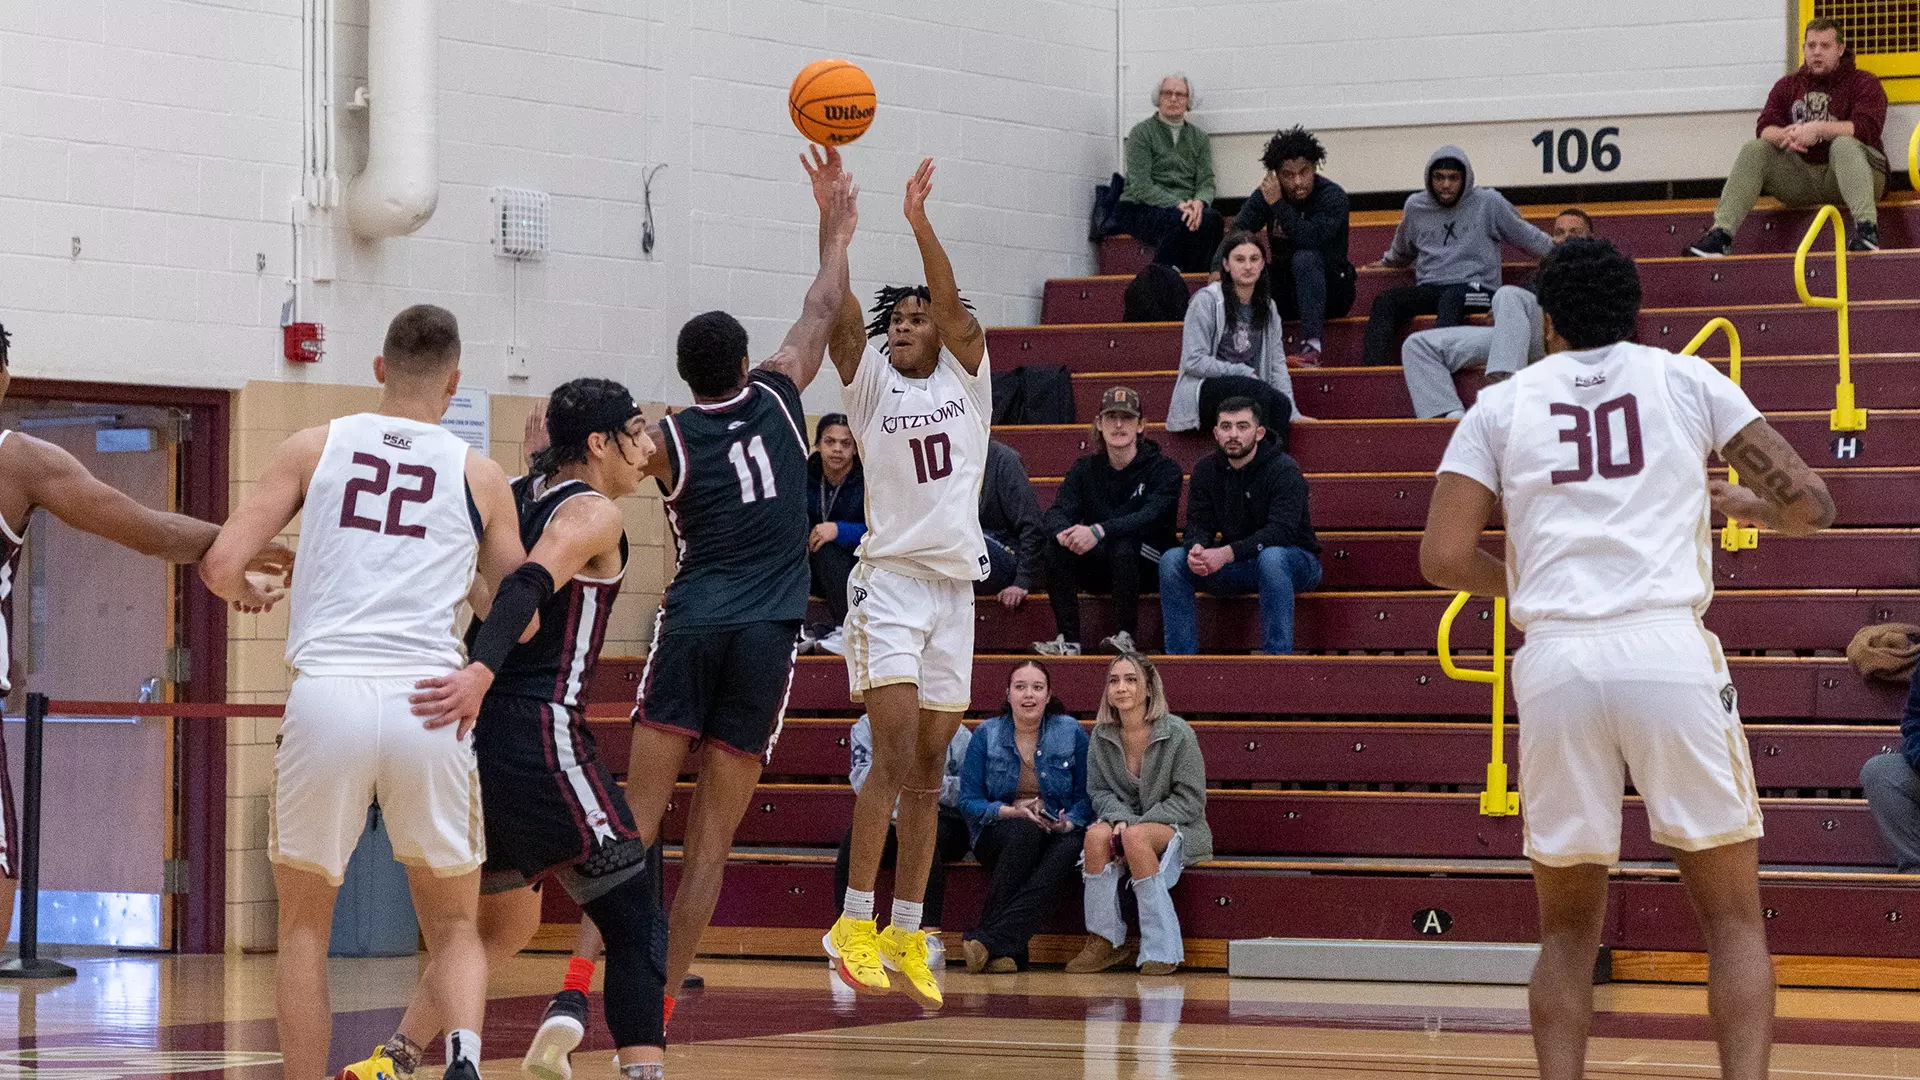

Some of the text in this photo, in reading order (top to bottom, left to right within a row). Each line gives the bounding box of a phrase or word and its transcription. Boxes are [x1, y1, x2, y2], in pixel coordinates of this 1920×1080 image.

[824, 105, 875, 121] Wilson
[1531, 126, 1622, 173] 106
[880, 397, 966, 433] KUTZTOWN
[383, 433, 413, 448] PSAC
[1549, 393, 1645, 485] 30
[1837, 437, 1857, 459] H
[728, 435, 777, 503] 11
[908, 432, 953, 484] 10
[339, 452, 437, 539] 22
[1339, 550, 1345, 558] 7
[1827, 820, 1833, 829] 2
[1422, 910, 1442, 933] A
[1766, 909, 1773, 918] 2
[1890, 912, 1897, 921] 3
